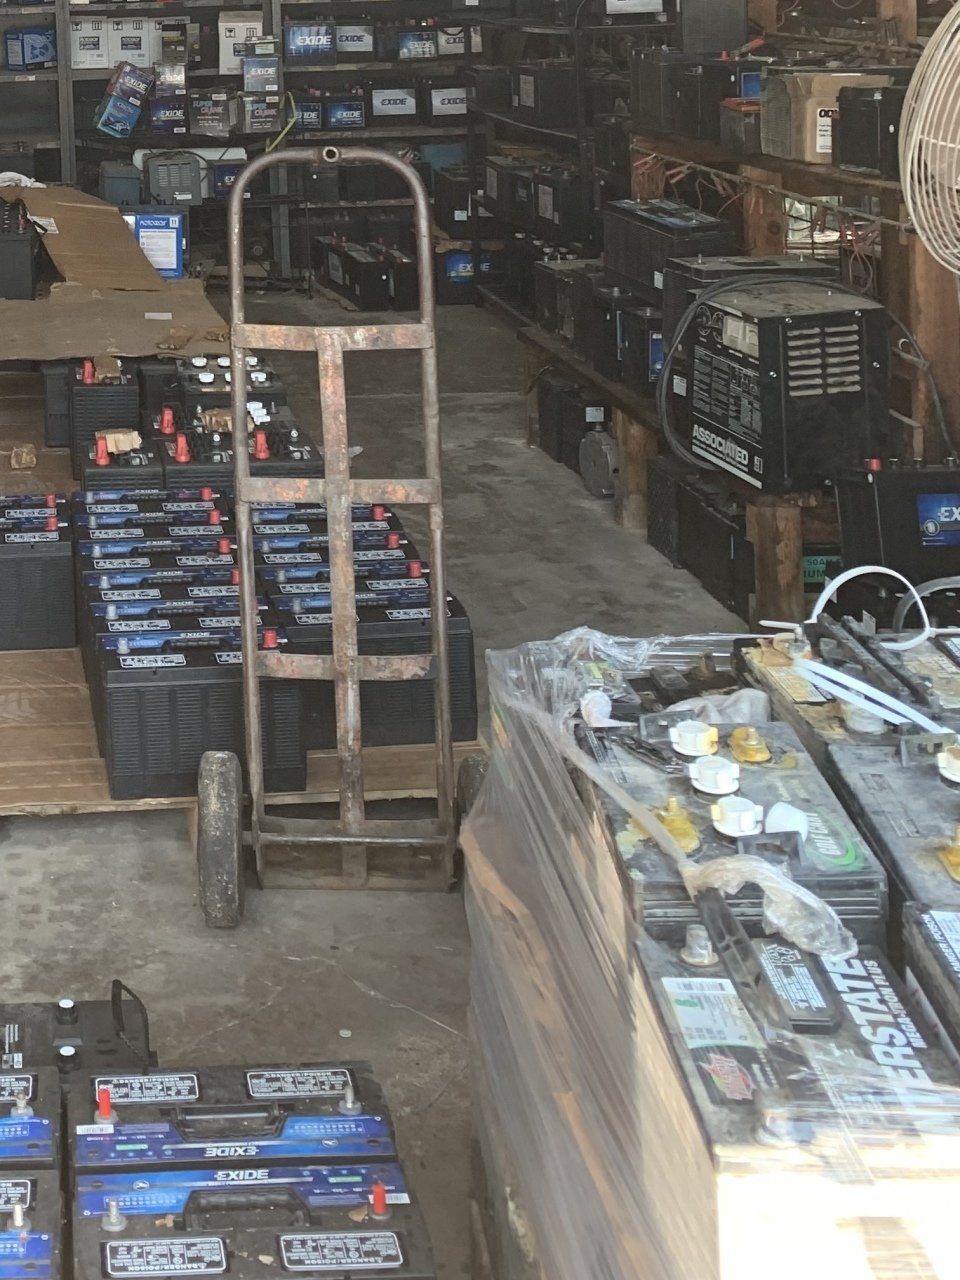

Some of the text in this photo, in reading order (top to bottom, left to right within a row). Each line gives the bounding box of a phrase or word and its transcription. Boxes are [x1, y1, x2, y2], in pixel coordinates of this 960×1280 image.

[297, 35, 332, 46] EXIDE
[338, 34, 365, 43] EXIDE
[381, 97, 407, 106] EXIDE
[440, 97, 468, 106] EXIDE
[159, 109, 184, 118] EXIDE
[337, 110, 362, 119] EXIDE
[692, 423, 749, 466] ASSOCIATED
[863, 959, 891, 993] PLUS
[204, 1146, 259, 1157] EXIDE
[214, 1169, 269, 1181] EXIDE
[128, 1264, 199, 1272] DANGER/POISON
